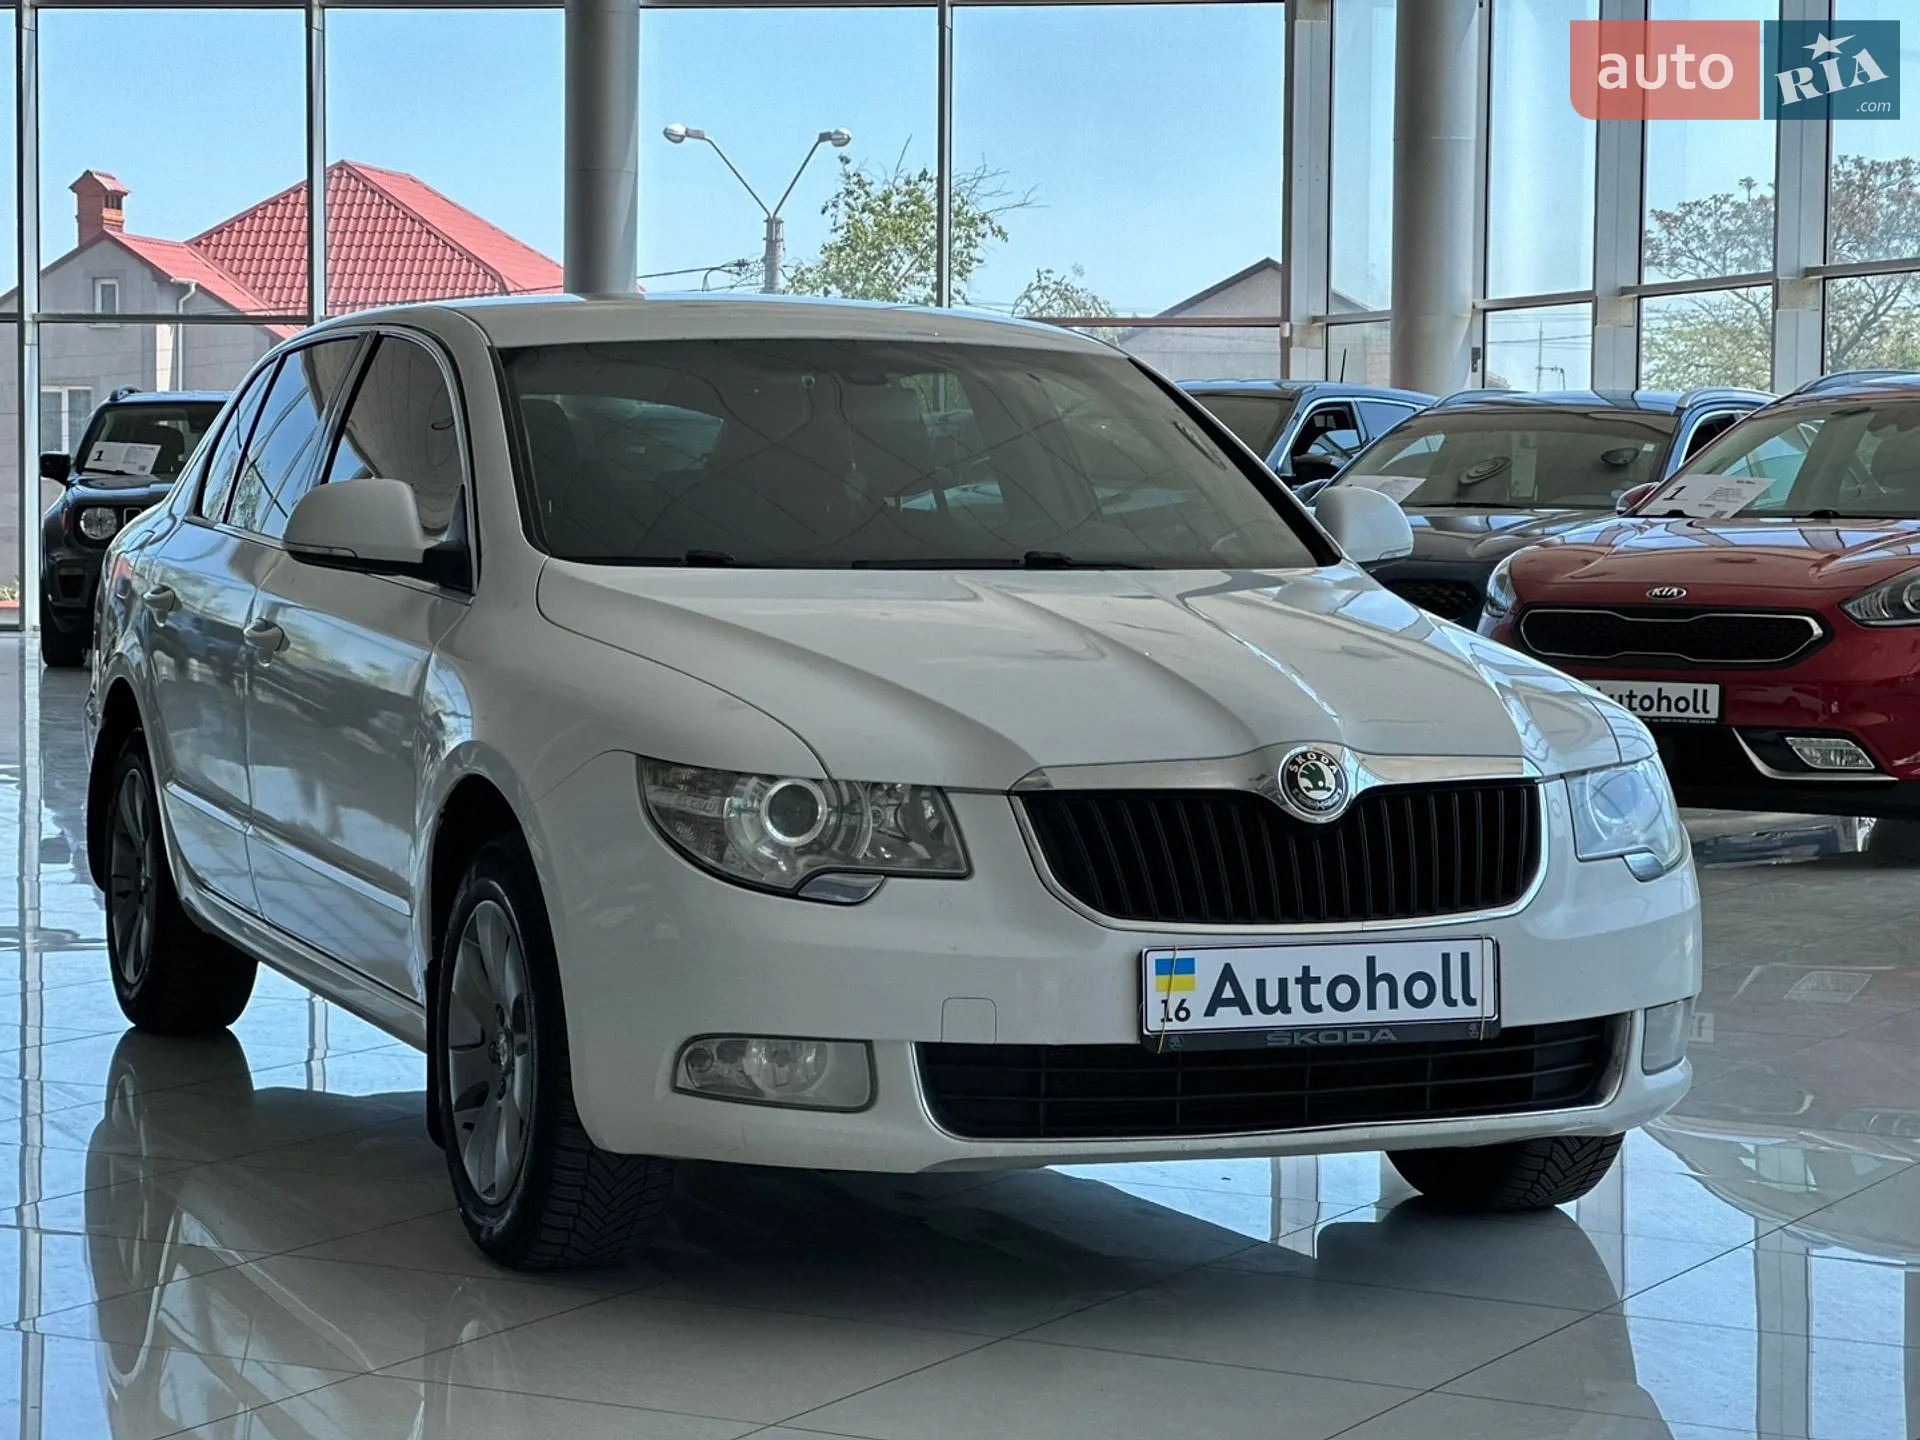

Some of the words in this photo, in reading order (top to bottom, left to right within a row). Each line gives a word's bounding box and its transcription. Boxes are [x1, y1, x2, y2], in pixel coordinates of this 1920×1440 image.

[1651, 587, 1678, 596] KIA
[1597, 686, 1710, 714] toholl
[1203, 952, 1477, 1017] Autoholl
[1161, 998, 1191, 1023] 16
